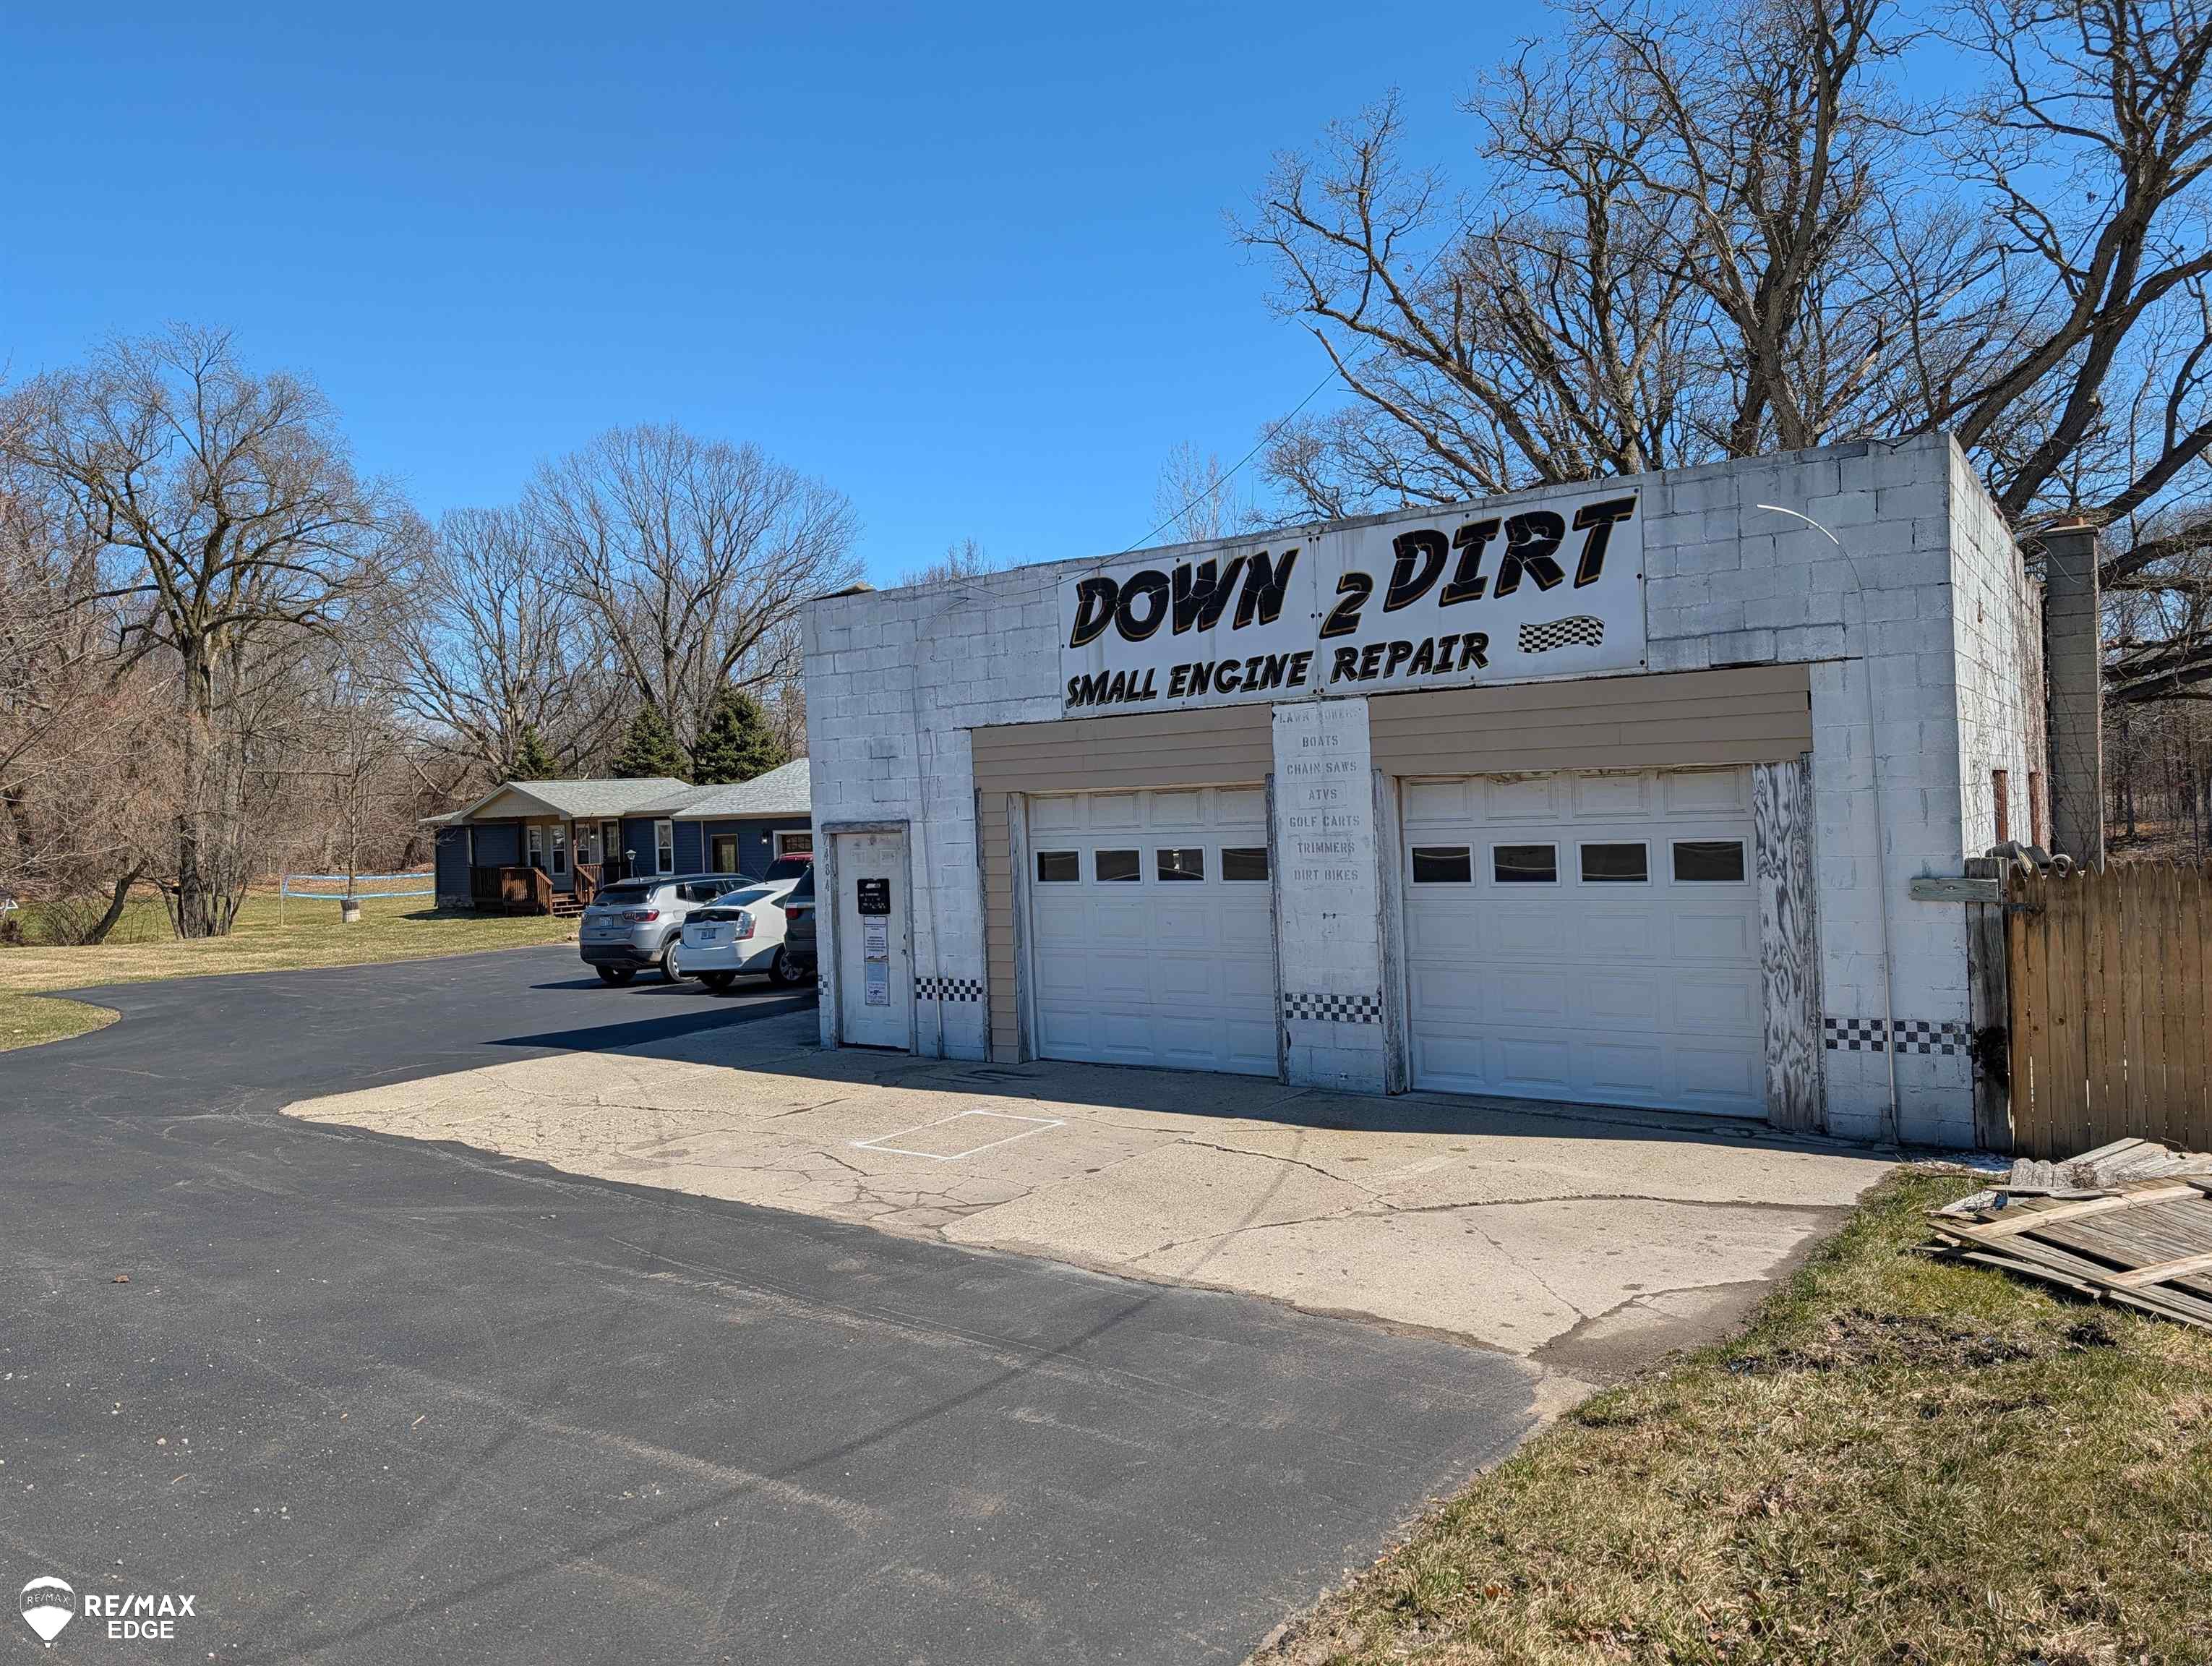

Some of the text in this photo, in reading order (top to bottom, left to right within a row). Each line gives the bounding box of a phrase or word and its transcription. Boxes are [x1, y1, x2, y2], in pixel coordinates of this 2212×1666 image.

[1071, 496, 1637, 649] DOWN 2 DIRT
[1065, 631, 1490, 709] SMALL ENGINE REPAIR
[1302, 735, 1339, 748] BOATS
[1287, 760, 1357, 775] CHAIN SAWS
[1308, 789, 1337, 800] ATVS
[1289, 815, 1360, 828] GOLF CARTS
[1297, 842, 1355, 854] TRIMMERS
[1294, 868, 1358, 881] DIRT BIKES
